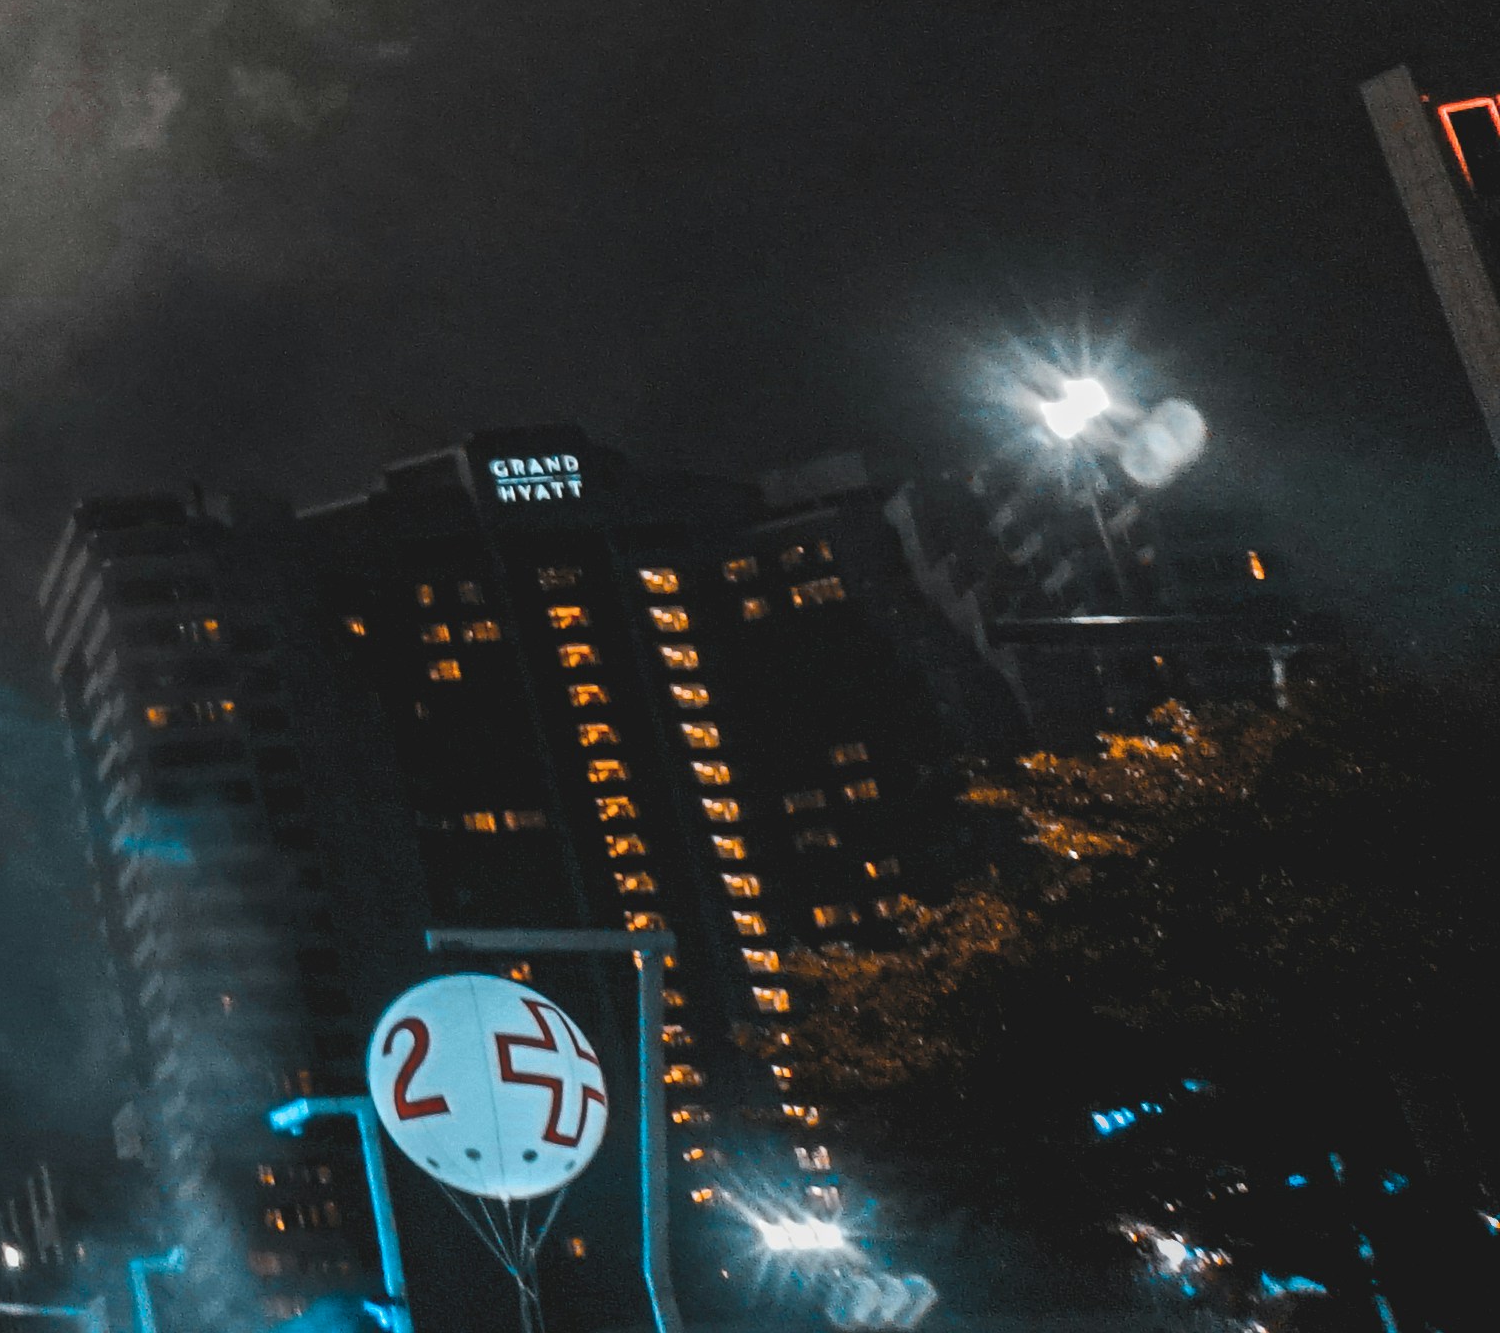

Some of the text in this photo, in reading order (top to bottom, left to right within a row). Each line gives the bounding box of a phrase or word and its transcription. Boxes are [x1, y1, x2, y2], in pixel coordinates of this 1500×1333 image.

[489, 453, 580, 478] GRAND
[496, 480, 583, 503] HYATT
[383, 1016, 451, 1121] 2
